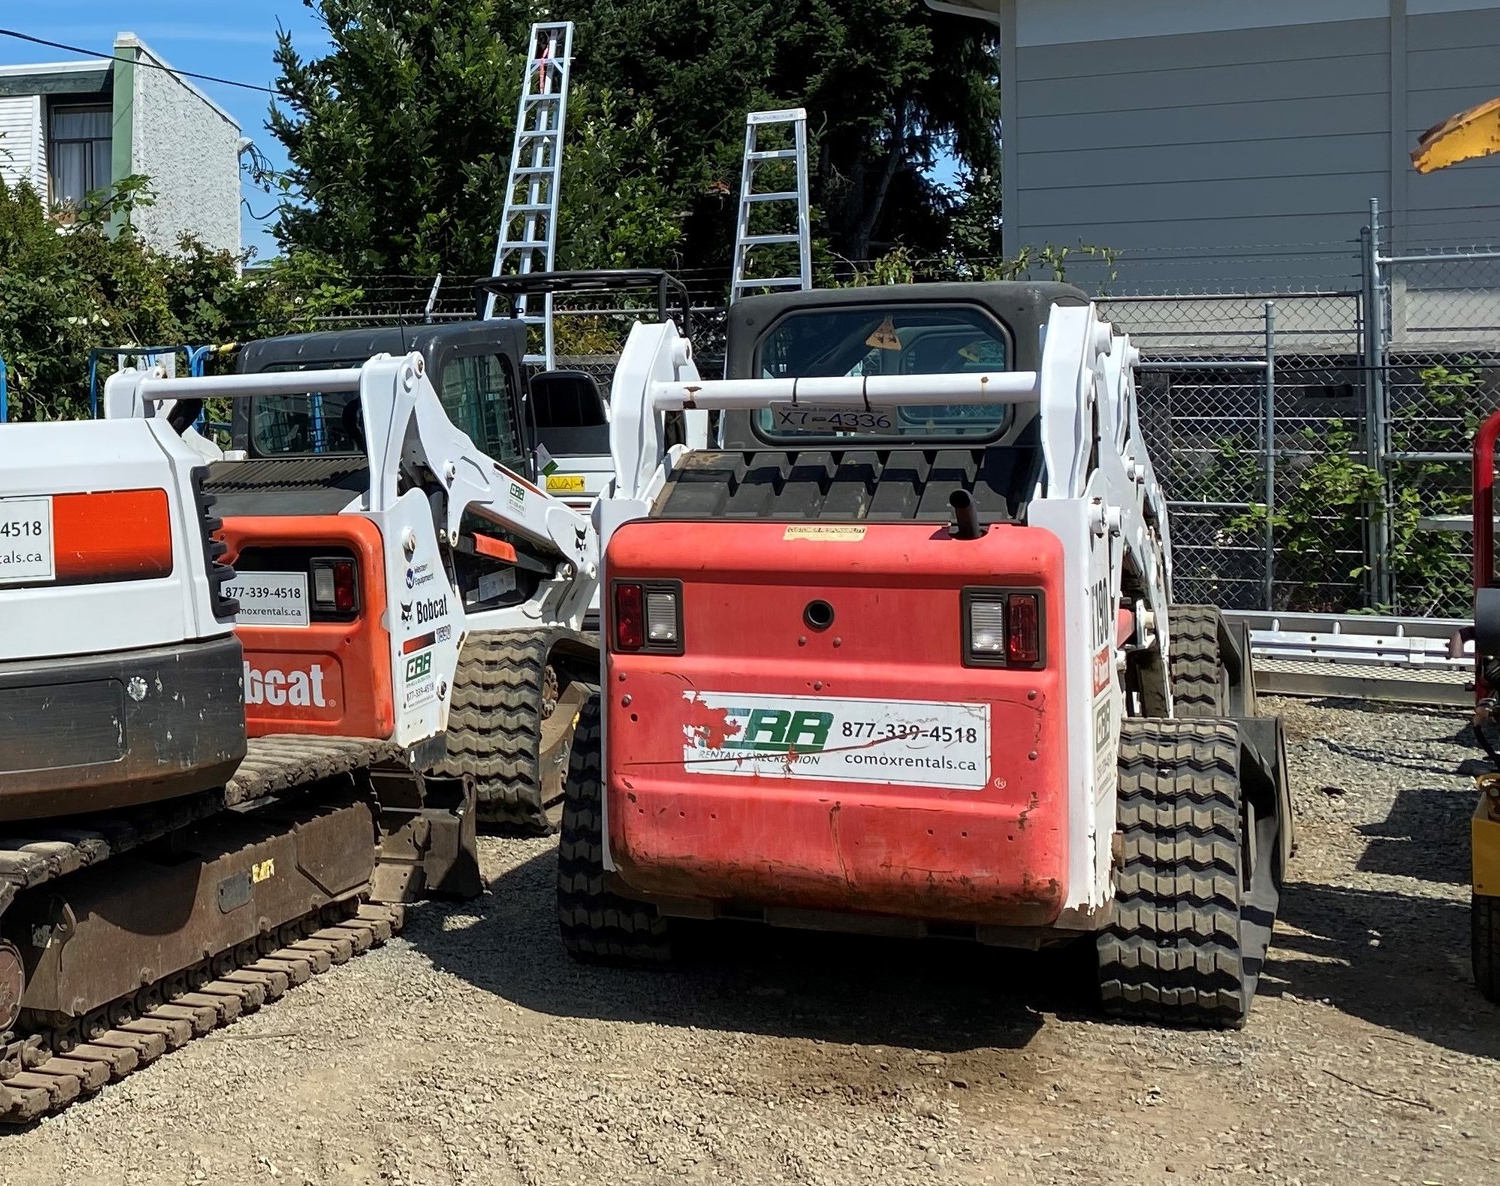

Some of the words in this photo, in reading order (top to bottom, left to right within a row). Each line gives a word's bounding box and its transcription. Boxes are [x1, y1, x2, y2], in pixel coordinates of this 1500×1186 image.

[225, 587, 301, 599] 877-339-4518
[239, 607, 302, 617] moxrentals.ca
[416, 593, 448, 624] Bobcat
[243, 661, 326, 707] bcat
[842, 722, 977, 744] 877-339-4518
[699, 750, 743, 760] RENTALS
[844, 754, 977, 771] comoxrentals.ca
